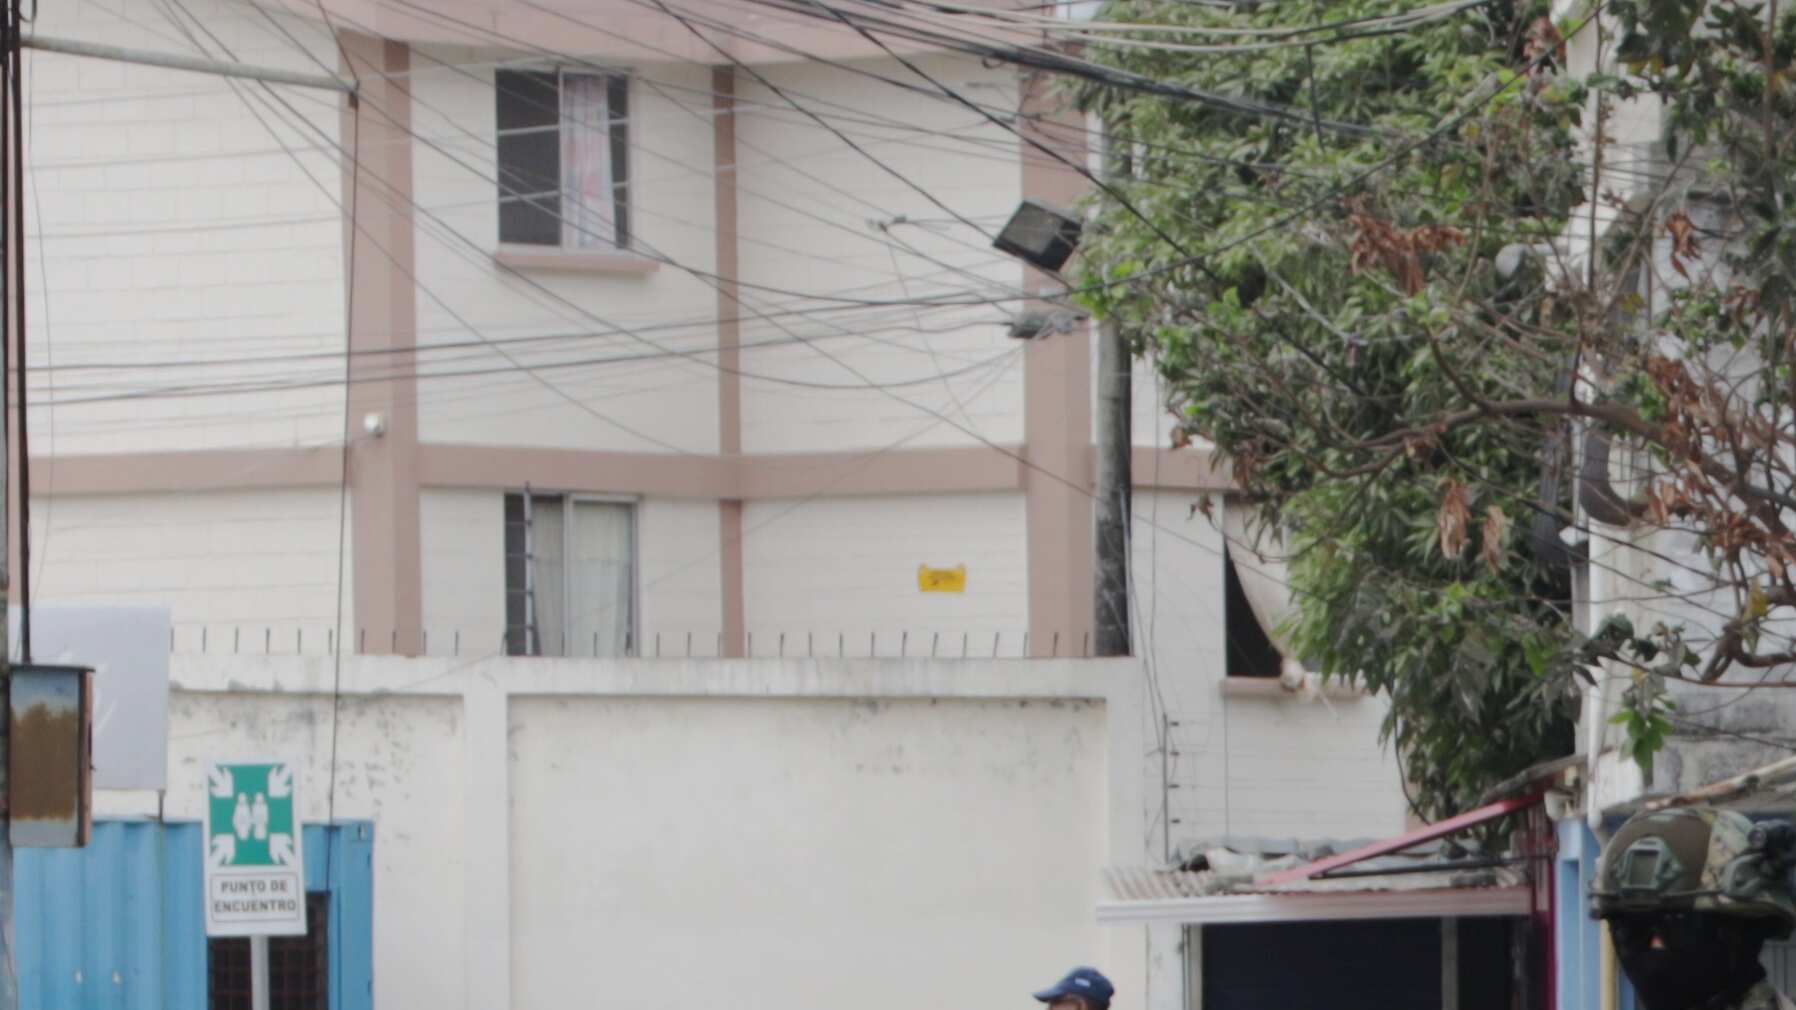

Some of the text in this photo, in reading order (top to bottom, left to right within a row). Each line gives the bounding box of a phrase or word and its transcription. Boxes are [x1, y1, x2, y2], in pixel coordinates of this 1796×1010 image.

[221, 879, 288, 893] PUNTO DE
[214, 899, 297, 913] ENCUENTRO
